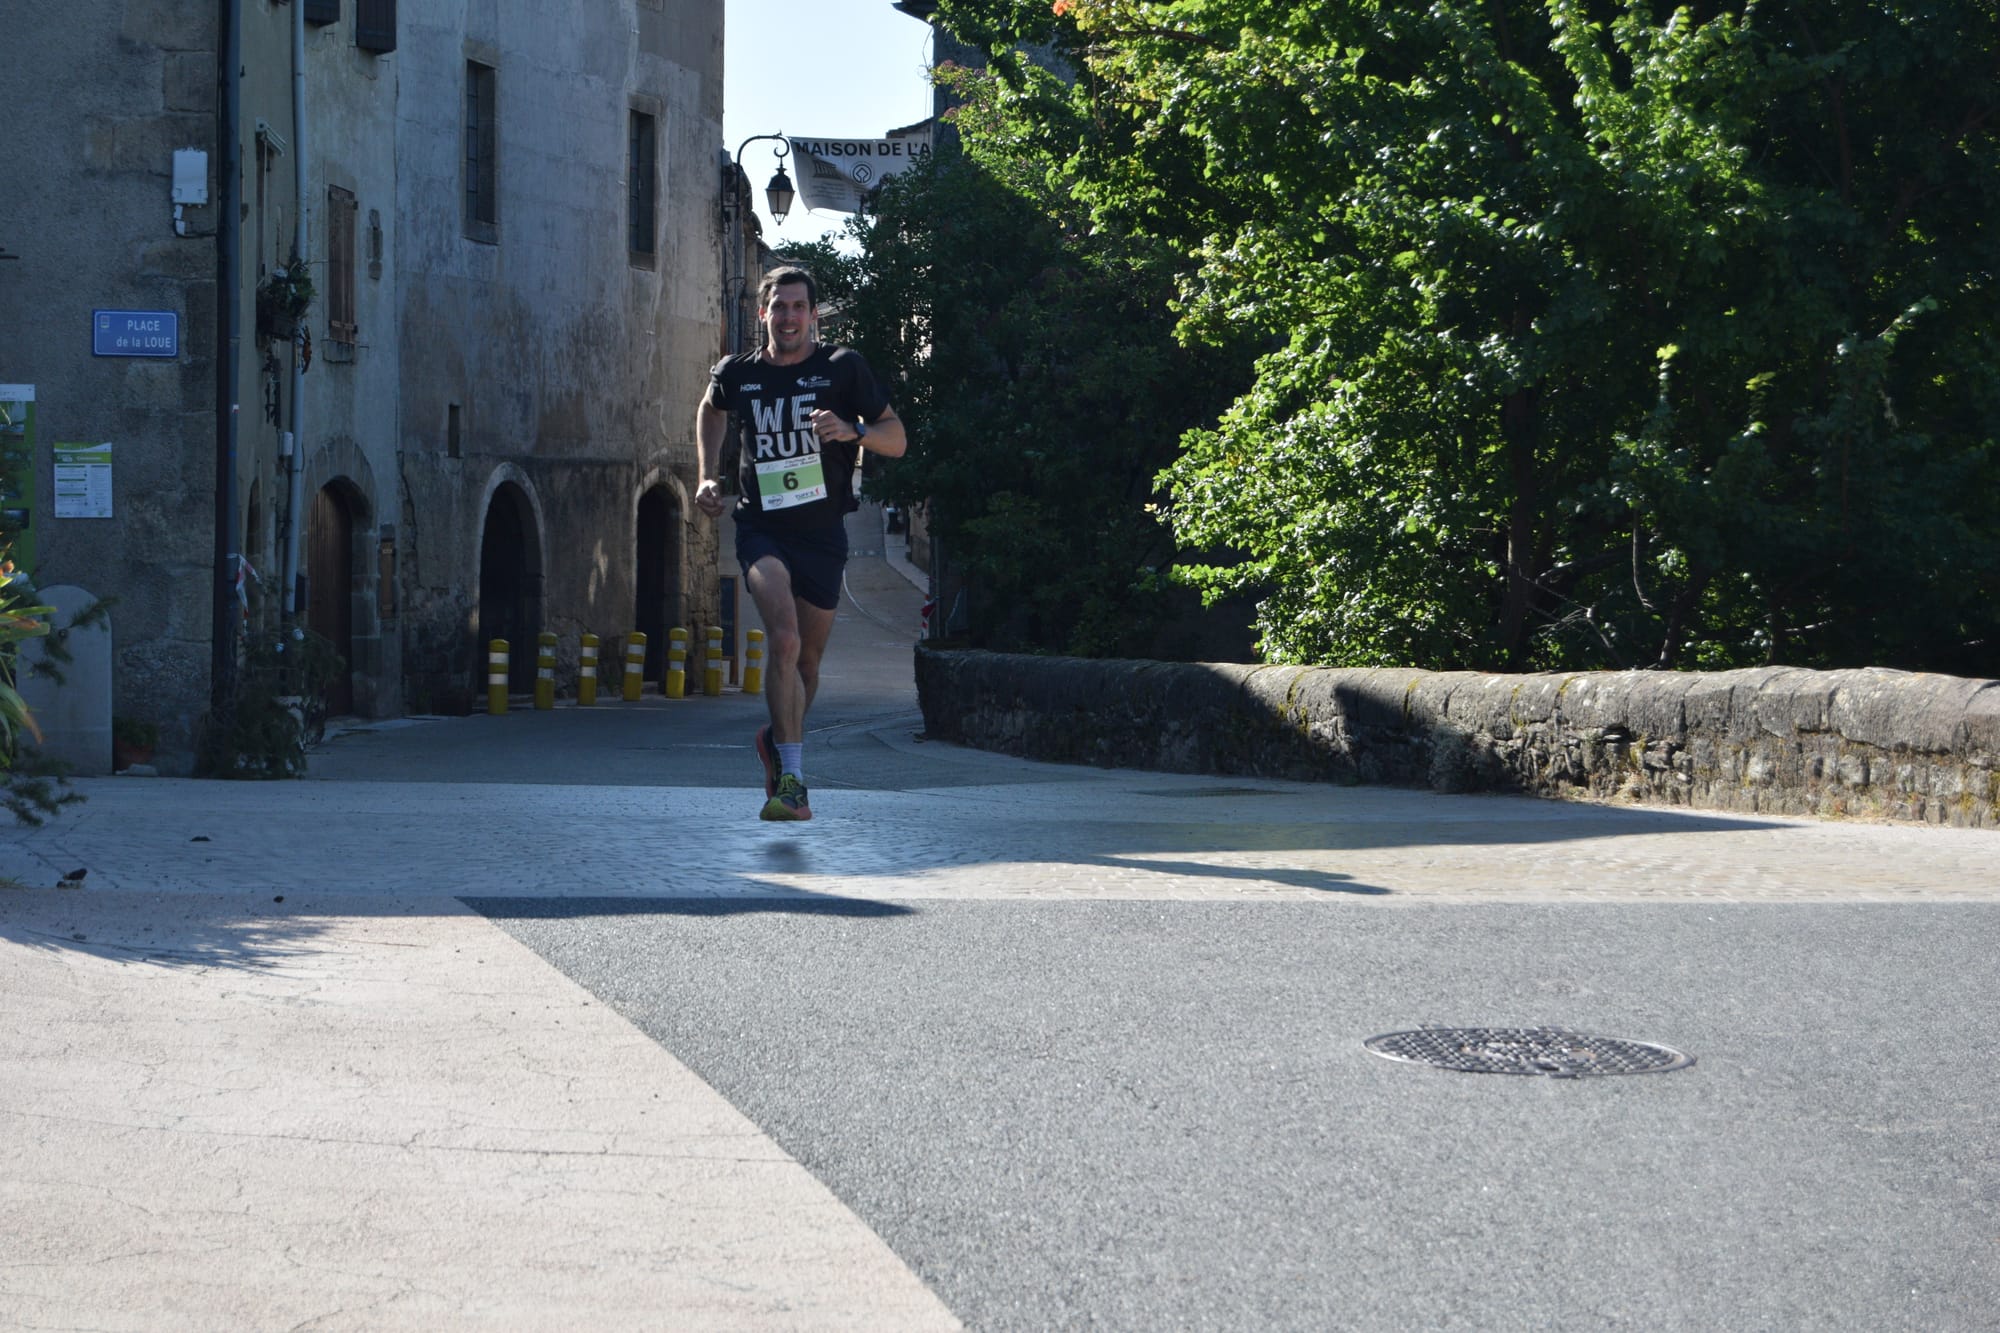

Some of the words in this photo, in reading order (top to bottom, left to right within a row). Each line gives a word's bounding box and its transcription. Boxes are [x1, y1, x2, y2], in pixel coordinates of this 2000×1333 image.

[796, 142, 872, 156] MAISON
[878, 143, 902, 156] DE
[127, 320, 160, 331] PLACE
[116, 336, 128, 347] de
[145, 337, 172, 348] LOUE
[740, 383, 762, 392] HOKA
[751, 393, 816, 432] WE
[755, 431, 820, 458] RUN
[783, 472, 799, 490] 6
